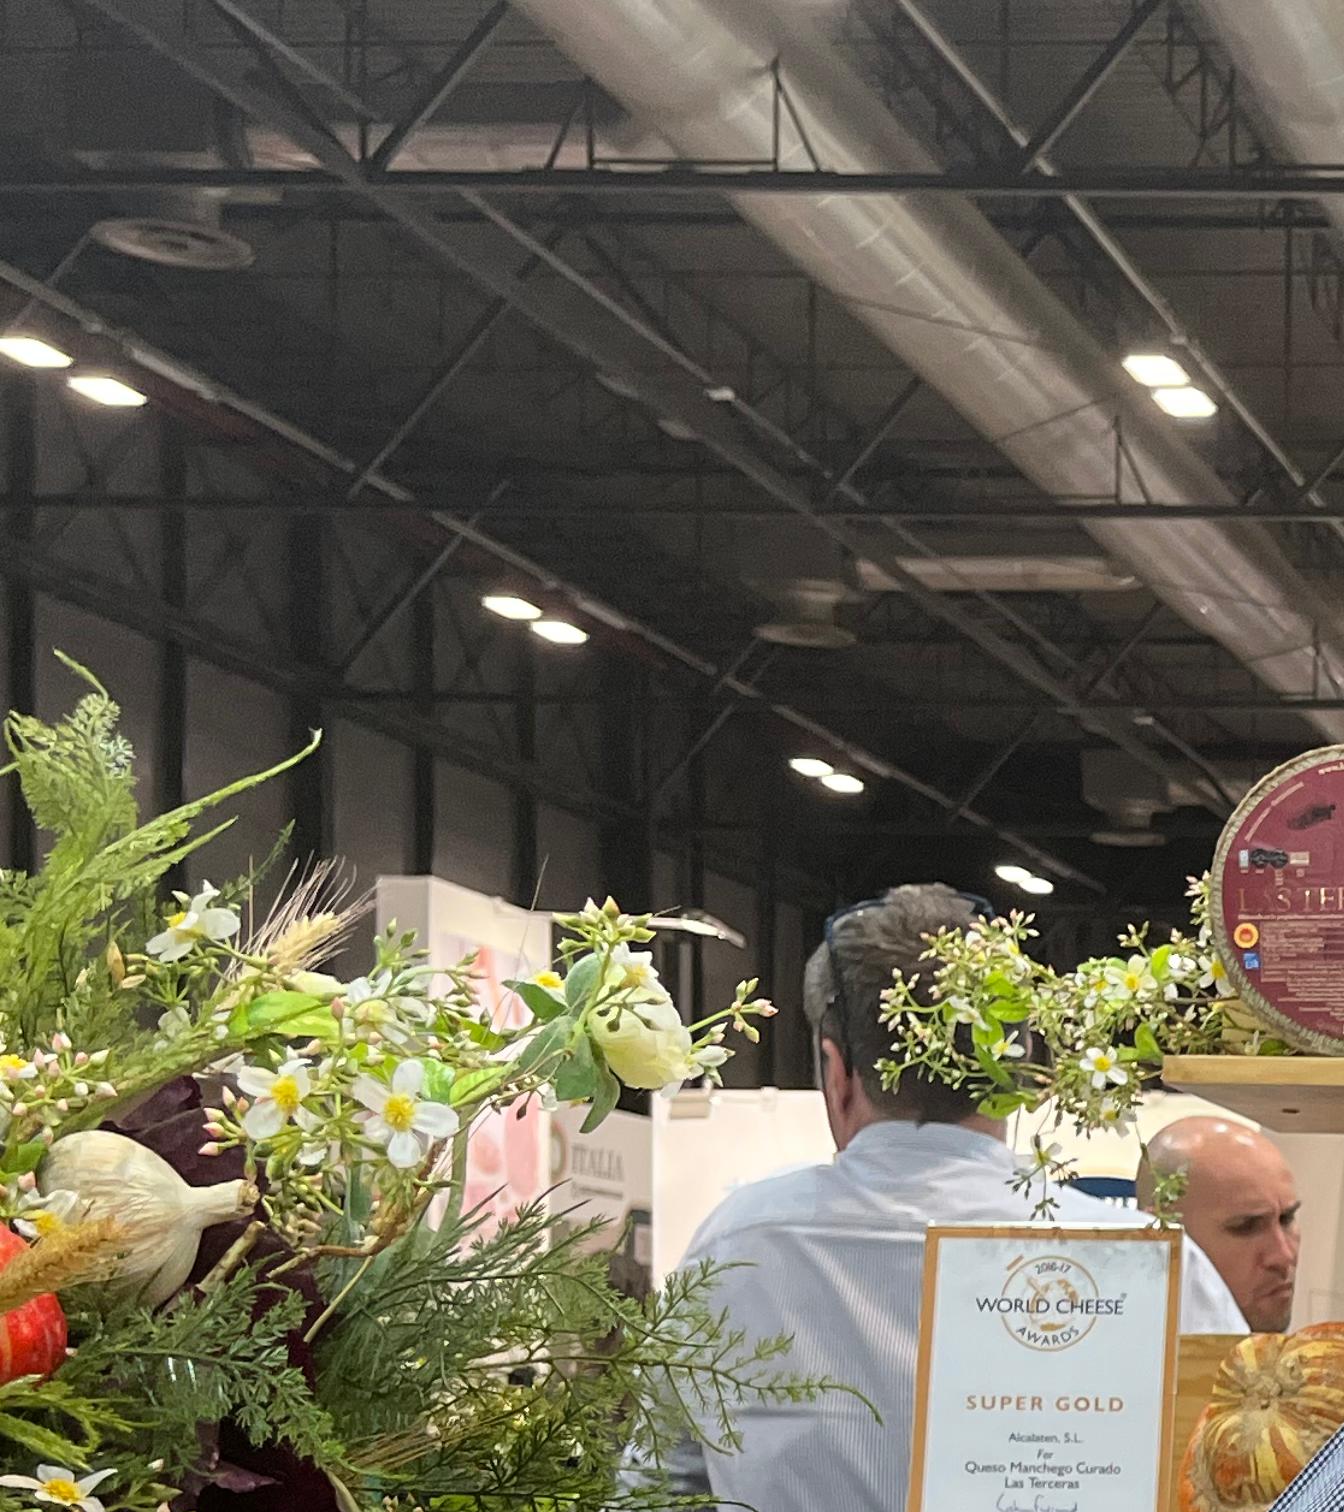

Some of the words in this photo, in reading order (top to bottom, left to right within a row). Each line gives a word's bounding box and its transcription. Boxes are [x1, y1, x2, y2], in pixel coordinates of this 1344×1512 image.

[976, 1297, 1050, 1314] WORLD
[1056, 1299, 1124, 1315] CHEESE
[1016, 1325, 1080, 1346] AWARDS
[966, 1395, 1044, 1411] SUPER
[1055, 1396, 1124, 1412] GOLD
[964, 1461, 1007, 1475] Queso
[1010, 1462, 1073, 1476] Manchego
[1076, 1462, 1121, 1475] Curado
[1004, 1477, 1024, 1489] Las
[1029, 1477, 1080, 1489] Terceras
